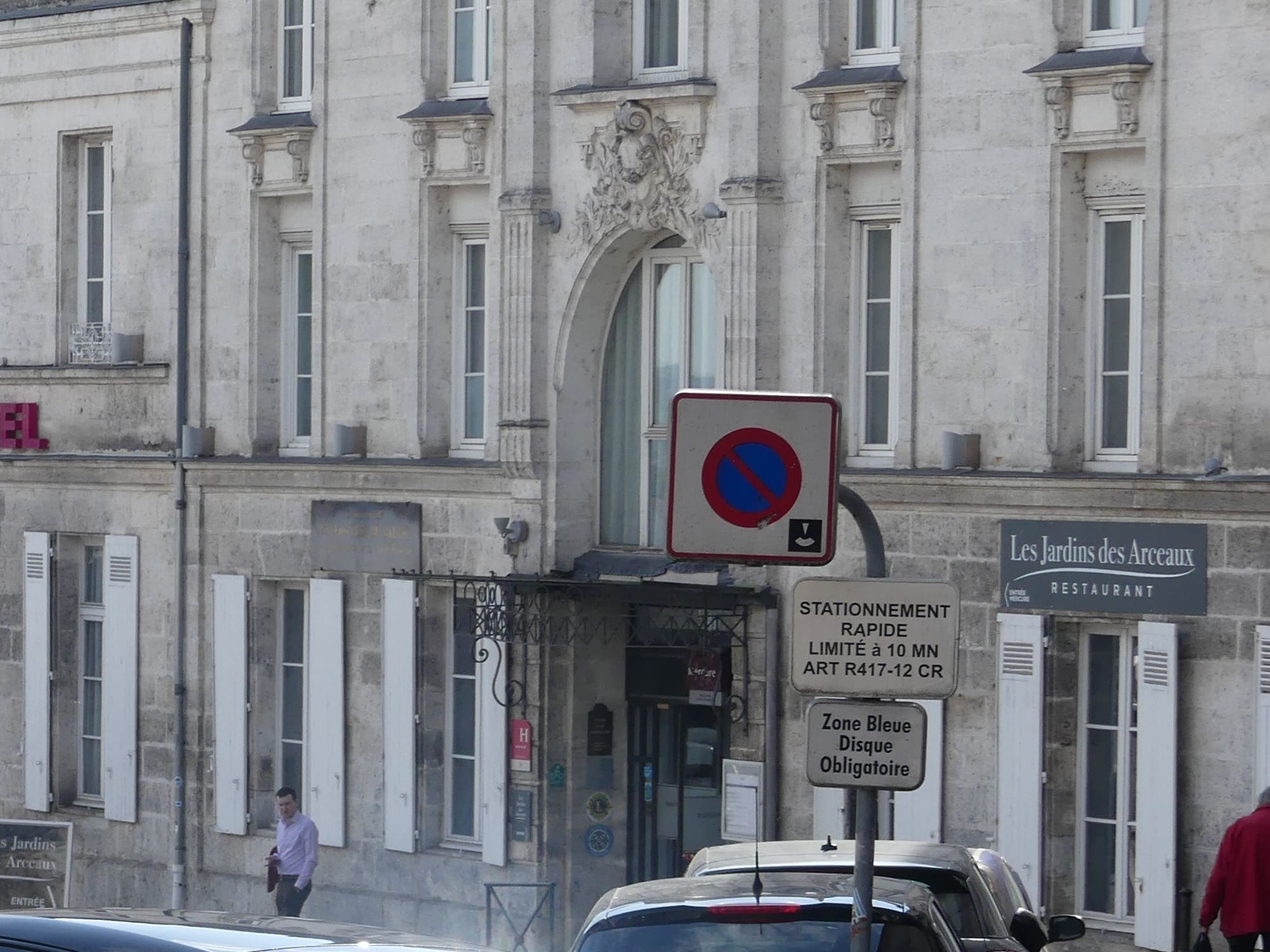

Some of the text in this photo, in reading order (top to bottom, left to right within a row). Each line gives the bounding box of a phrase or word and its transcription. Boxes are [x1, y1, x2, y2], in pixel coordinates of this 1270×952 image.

[1010, 534, 1195, 567] Les Jardins des Arceaux
[1051, 581, 1154, 598] RESTAURANT
[799, 601, 950, 619] STATIONNEMENT
[841, 622, 908, 638] RAPIDE
[809, 639, 939, 659] LIMITÉ à 10 MN
[803, 661, 944, 679] ART R417-12 CR
[821, 713, 912, 734] Zone Bleue
[519, 727, 529, 743] H
[839, 735, 893, 756] Disque
[820, 756, 910, 779] Obligatoire
[11, 835, 56, 851] Jardins
[5, 856, 57, 870] Arceaux
[10, 896, 45, 907] ENTRÉE
